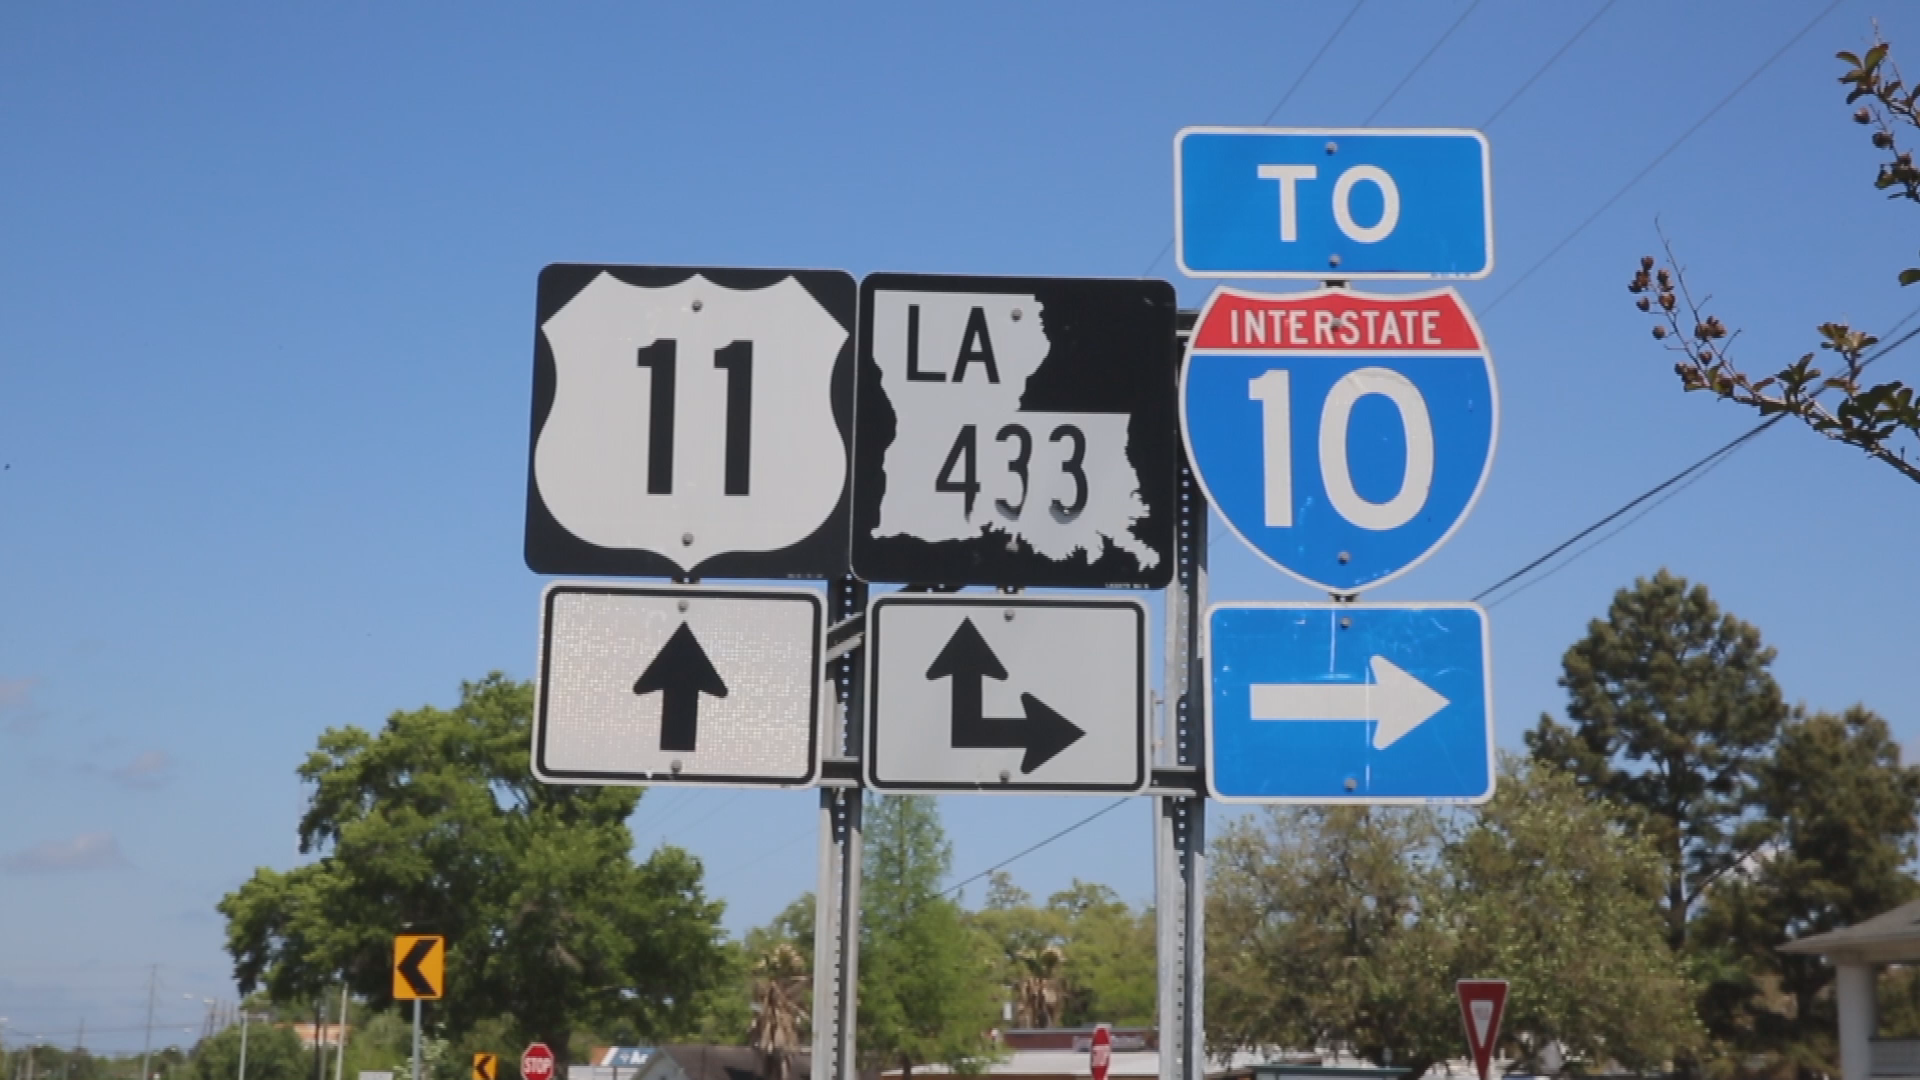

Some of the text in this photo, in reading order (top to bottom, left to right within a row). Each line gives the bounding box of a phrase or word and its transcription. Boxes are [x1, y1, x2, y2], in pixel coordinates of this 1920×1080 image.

[1257, 164, 1400, 243] TO
[906, 304, 1001, 384] LA
[1230, 309, 1442, 345] INTERSTATE
[636, 338, 754, 496] 11
[1248, 366, 1435, 531] 10
[935, 424, 1089, 523] 433
[523, 1057, 552, 1074] STOP
